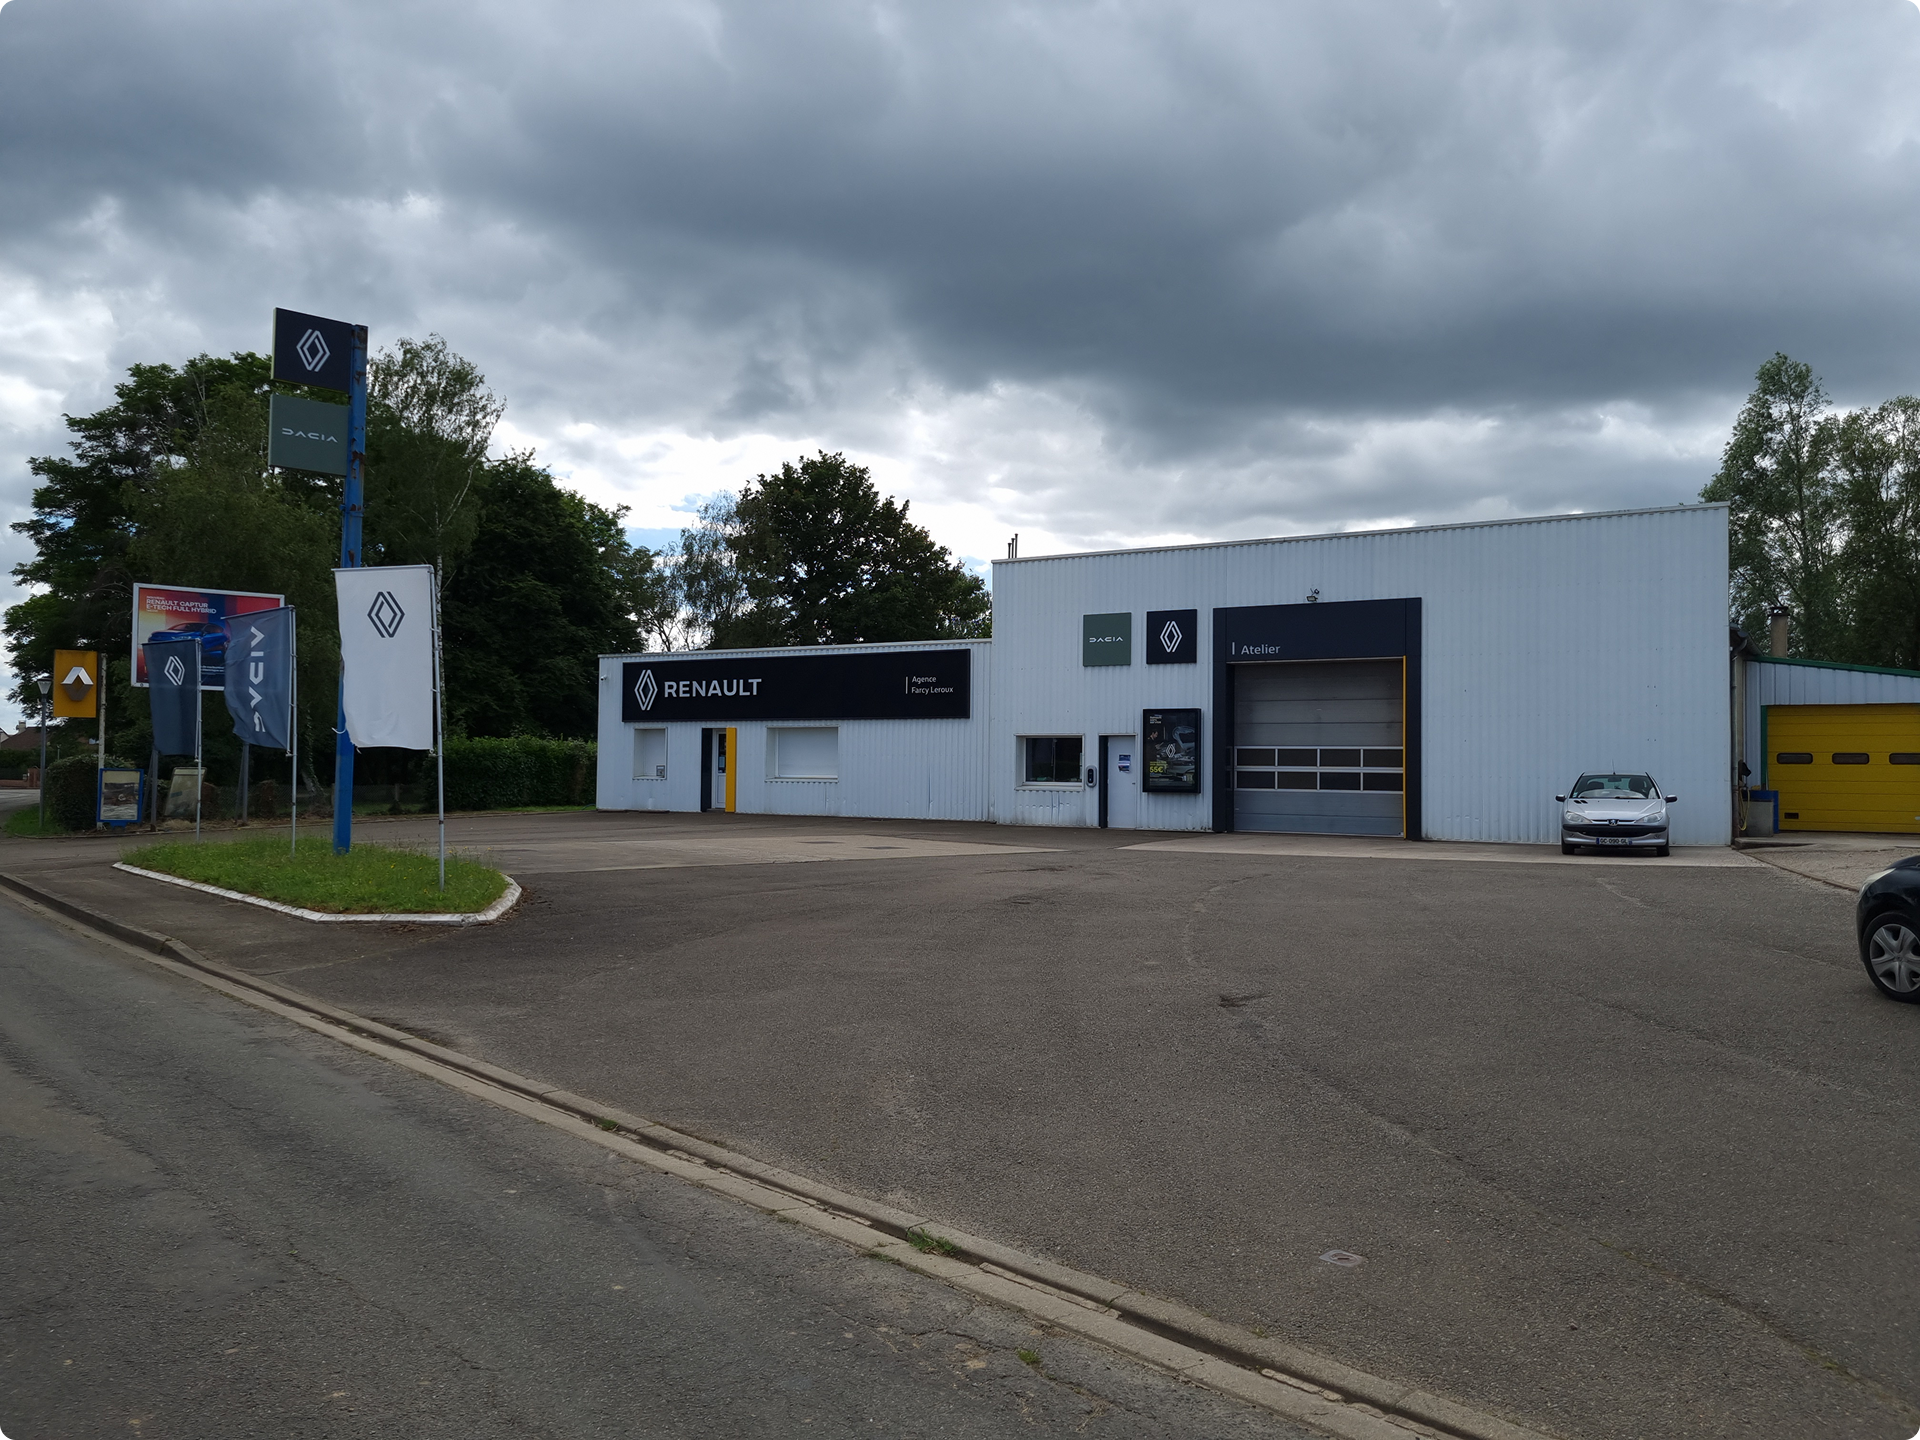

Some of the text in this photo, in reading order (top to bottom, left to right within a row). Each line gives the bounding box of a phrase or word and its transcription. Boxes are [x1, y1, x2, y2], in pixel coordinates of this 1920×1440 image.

[281, 427, 338, 443] DACIA
[146, 603, 172, 611] E-TECH
[1240, 644, 1281, 655] Atelier
[911, 675, 937, 685] Agence
[664, 678, 762, 698] RENAULT
[911, 686, 954, 695] Farcy Leroux
